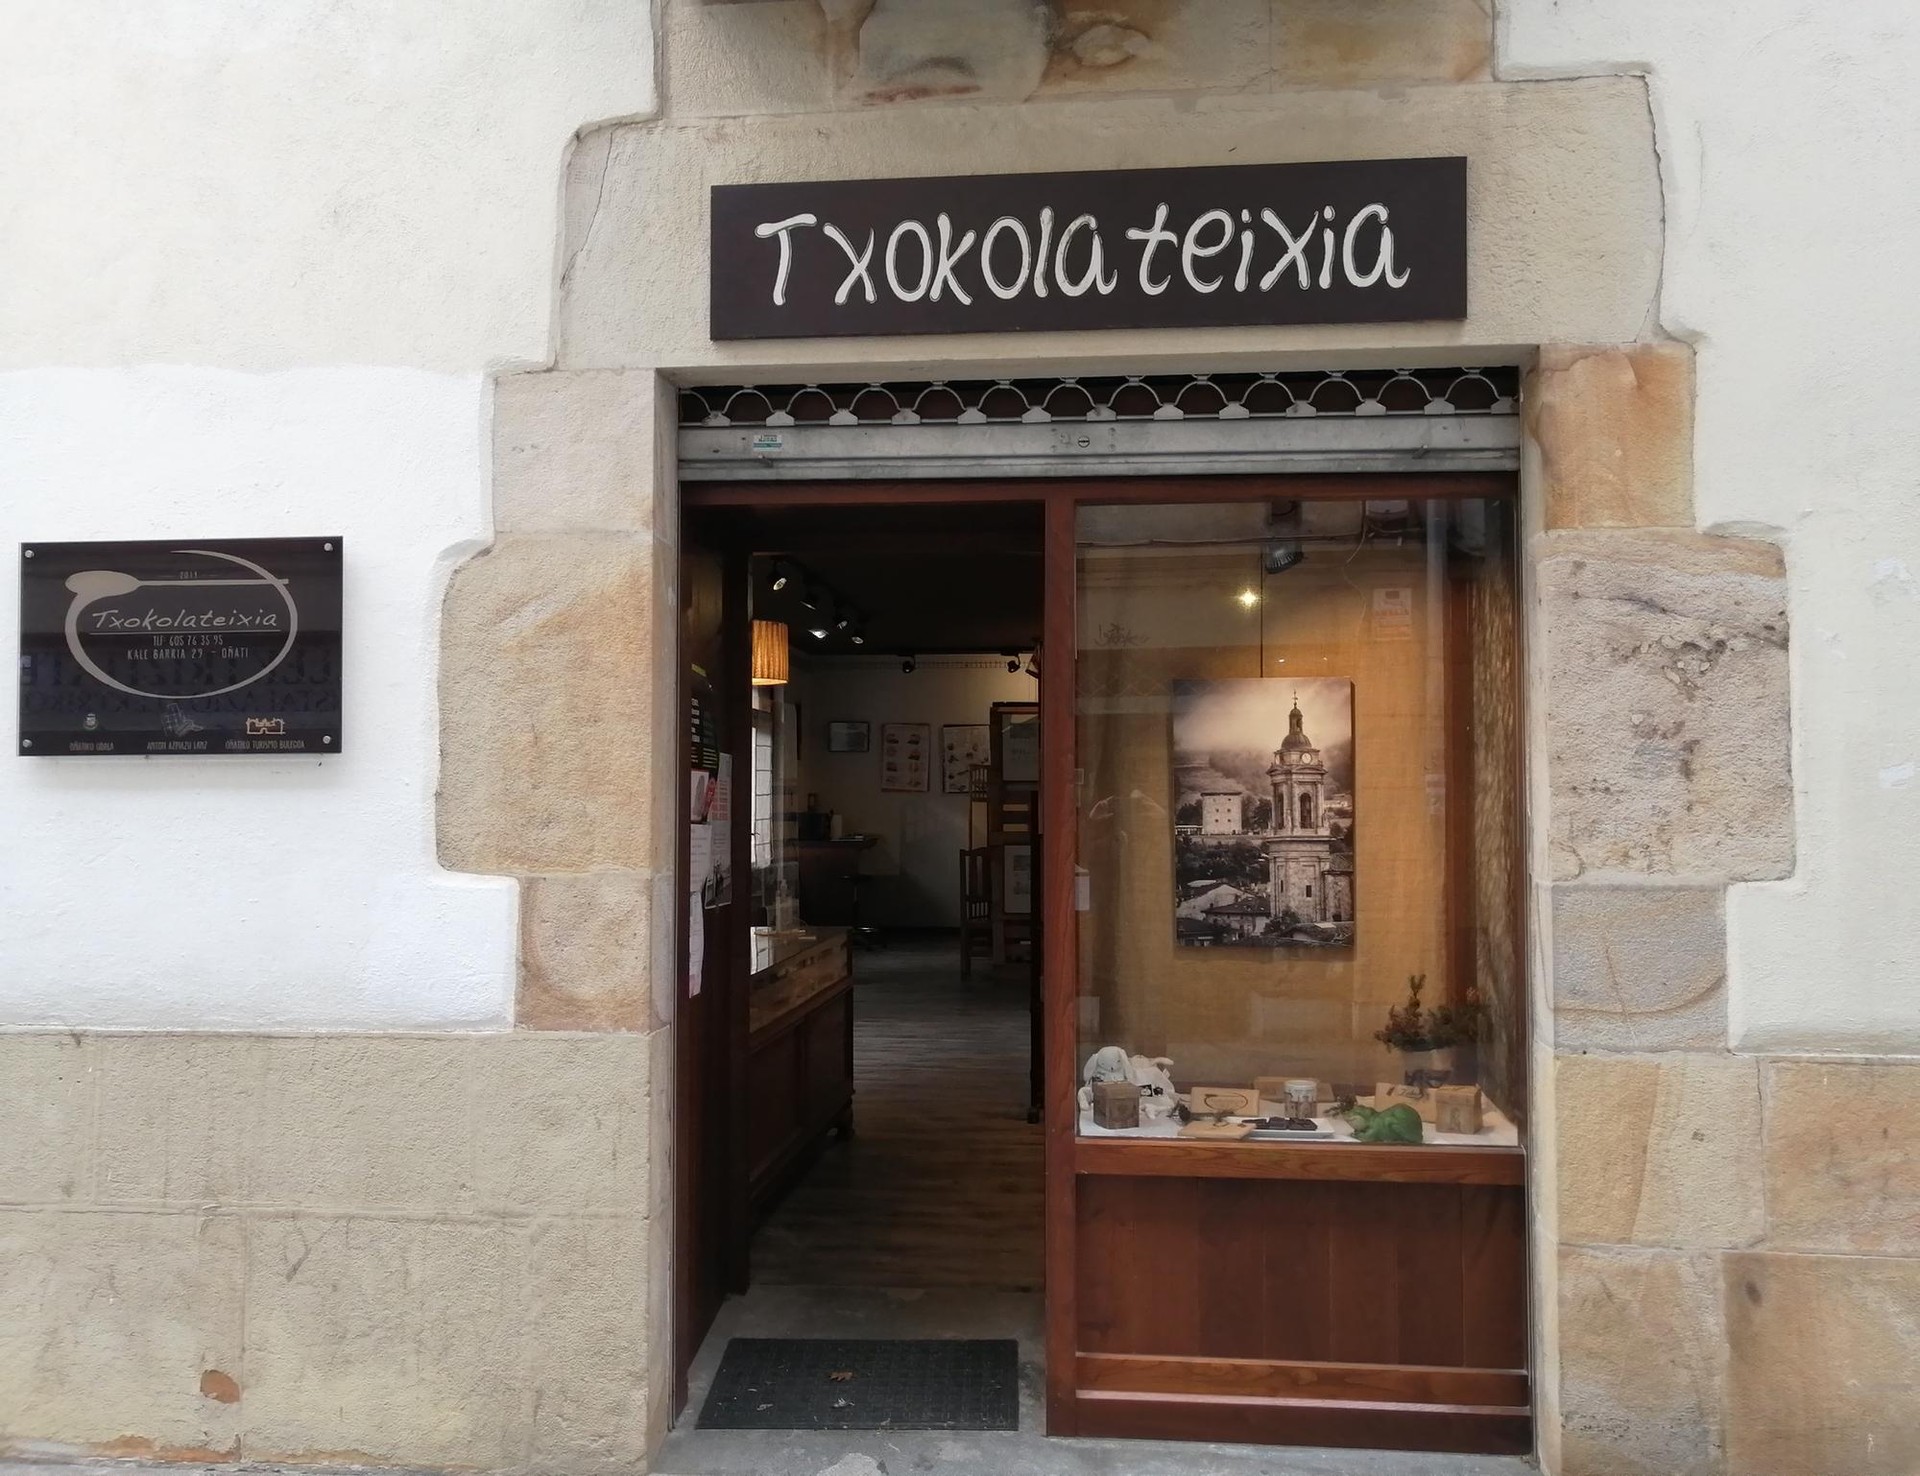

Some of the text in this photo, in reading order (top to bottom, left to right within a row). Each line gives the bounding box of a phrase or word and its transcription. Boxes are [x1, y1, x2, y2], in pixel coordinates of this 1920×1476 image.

[179, 571, 198, 580] 2011
[91, 608, 278, 630] Txokolateixia
[169, 634, 185, 647] 605
[187, 634, 198, 646] 76
[200, 634, 211, 646] 35
[213, 634, 224, 646] 95
[127, 648, 148, 660] KALE
[221, 645, 249, 659] OÑATI
